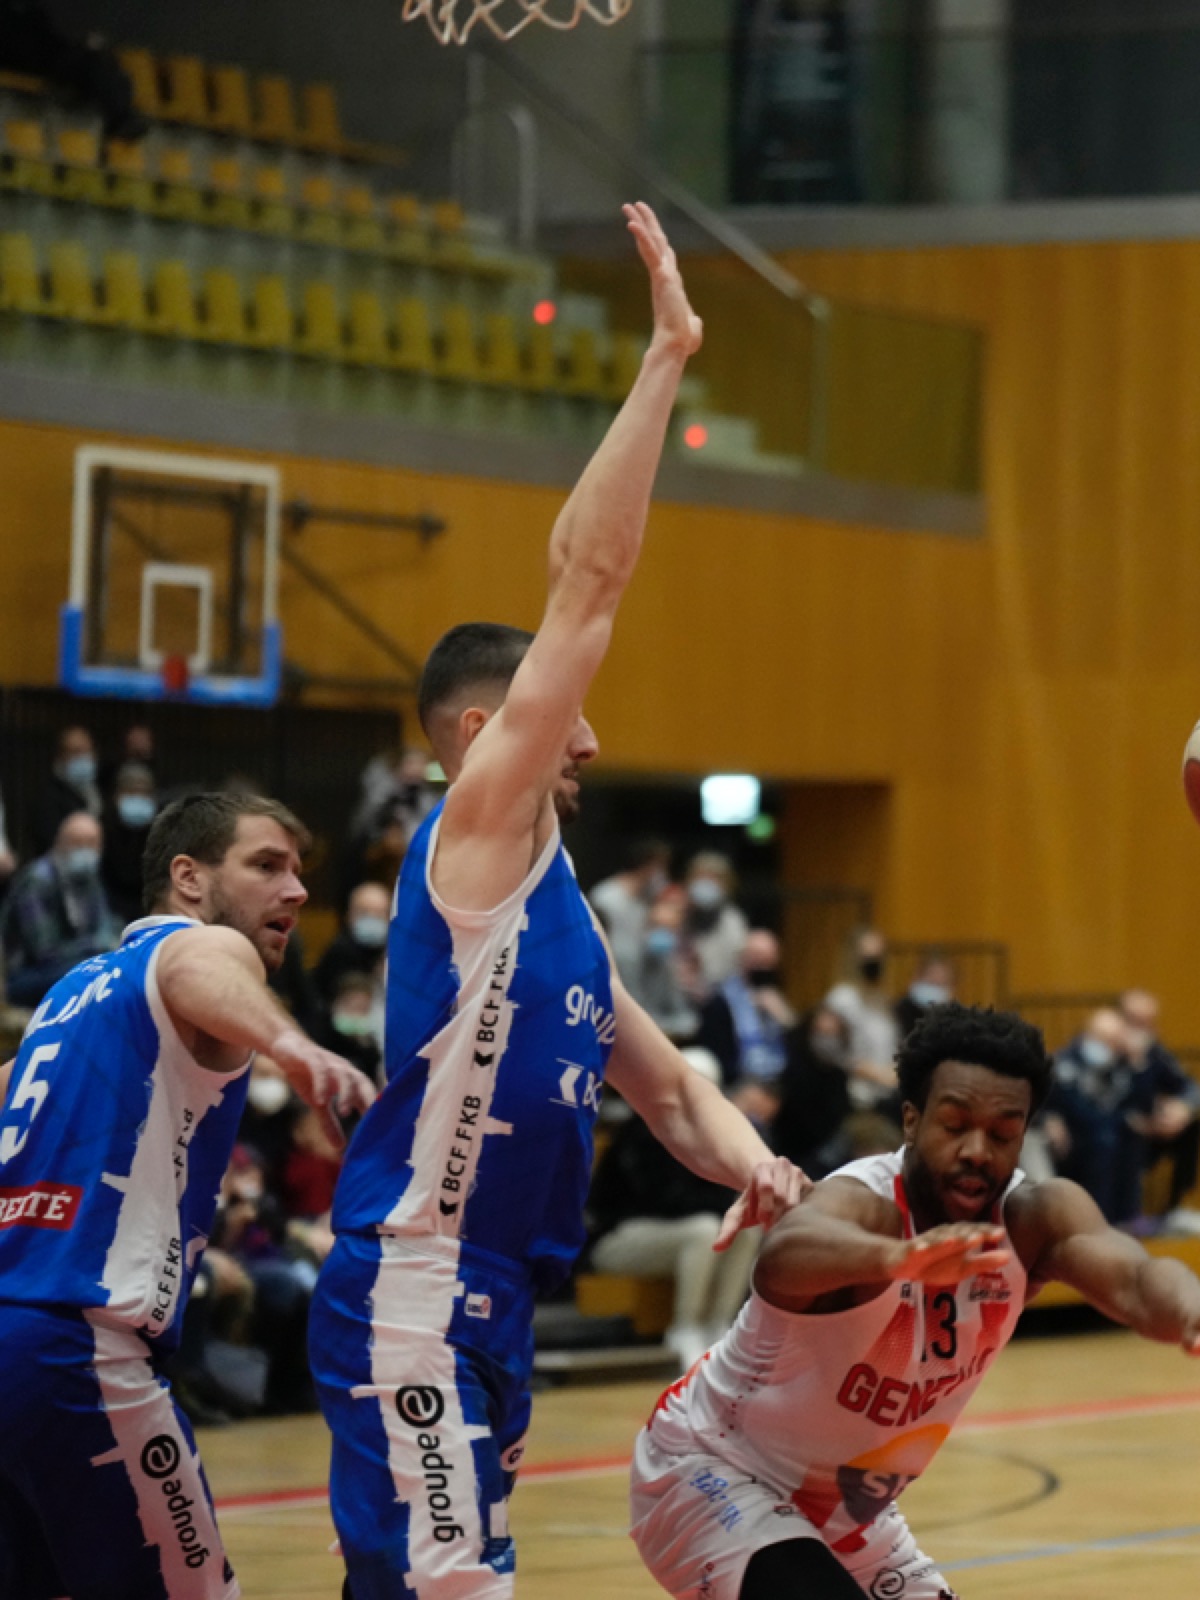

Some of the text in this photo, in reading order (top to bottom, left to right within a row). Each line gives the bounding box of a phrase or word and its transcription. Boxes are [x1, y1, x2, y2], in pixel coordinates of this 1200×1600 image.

[442, 1095, 481, 1193] BCF FKB
[151, 1282, 173, 1323] BCF
[162, 1480, 209, 1569] groupe
[417, 1433, 464, 1543] groupe
